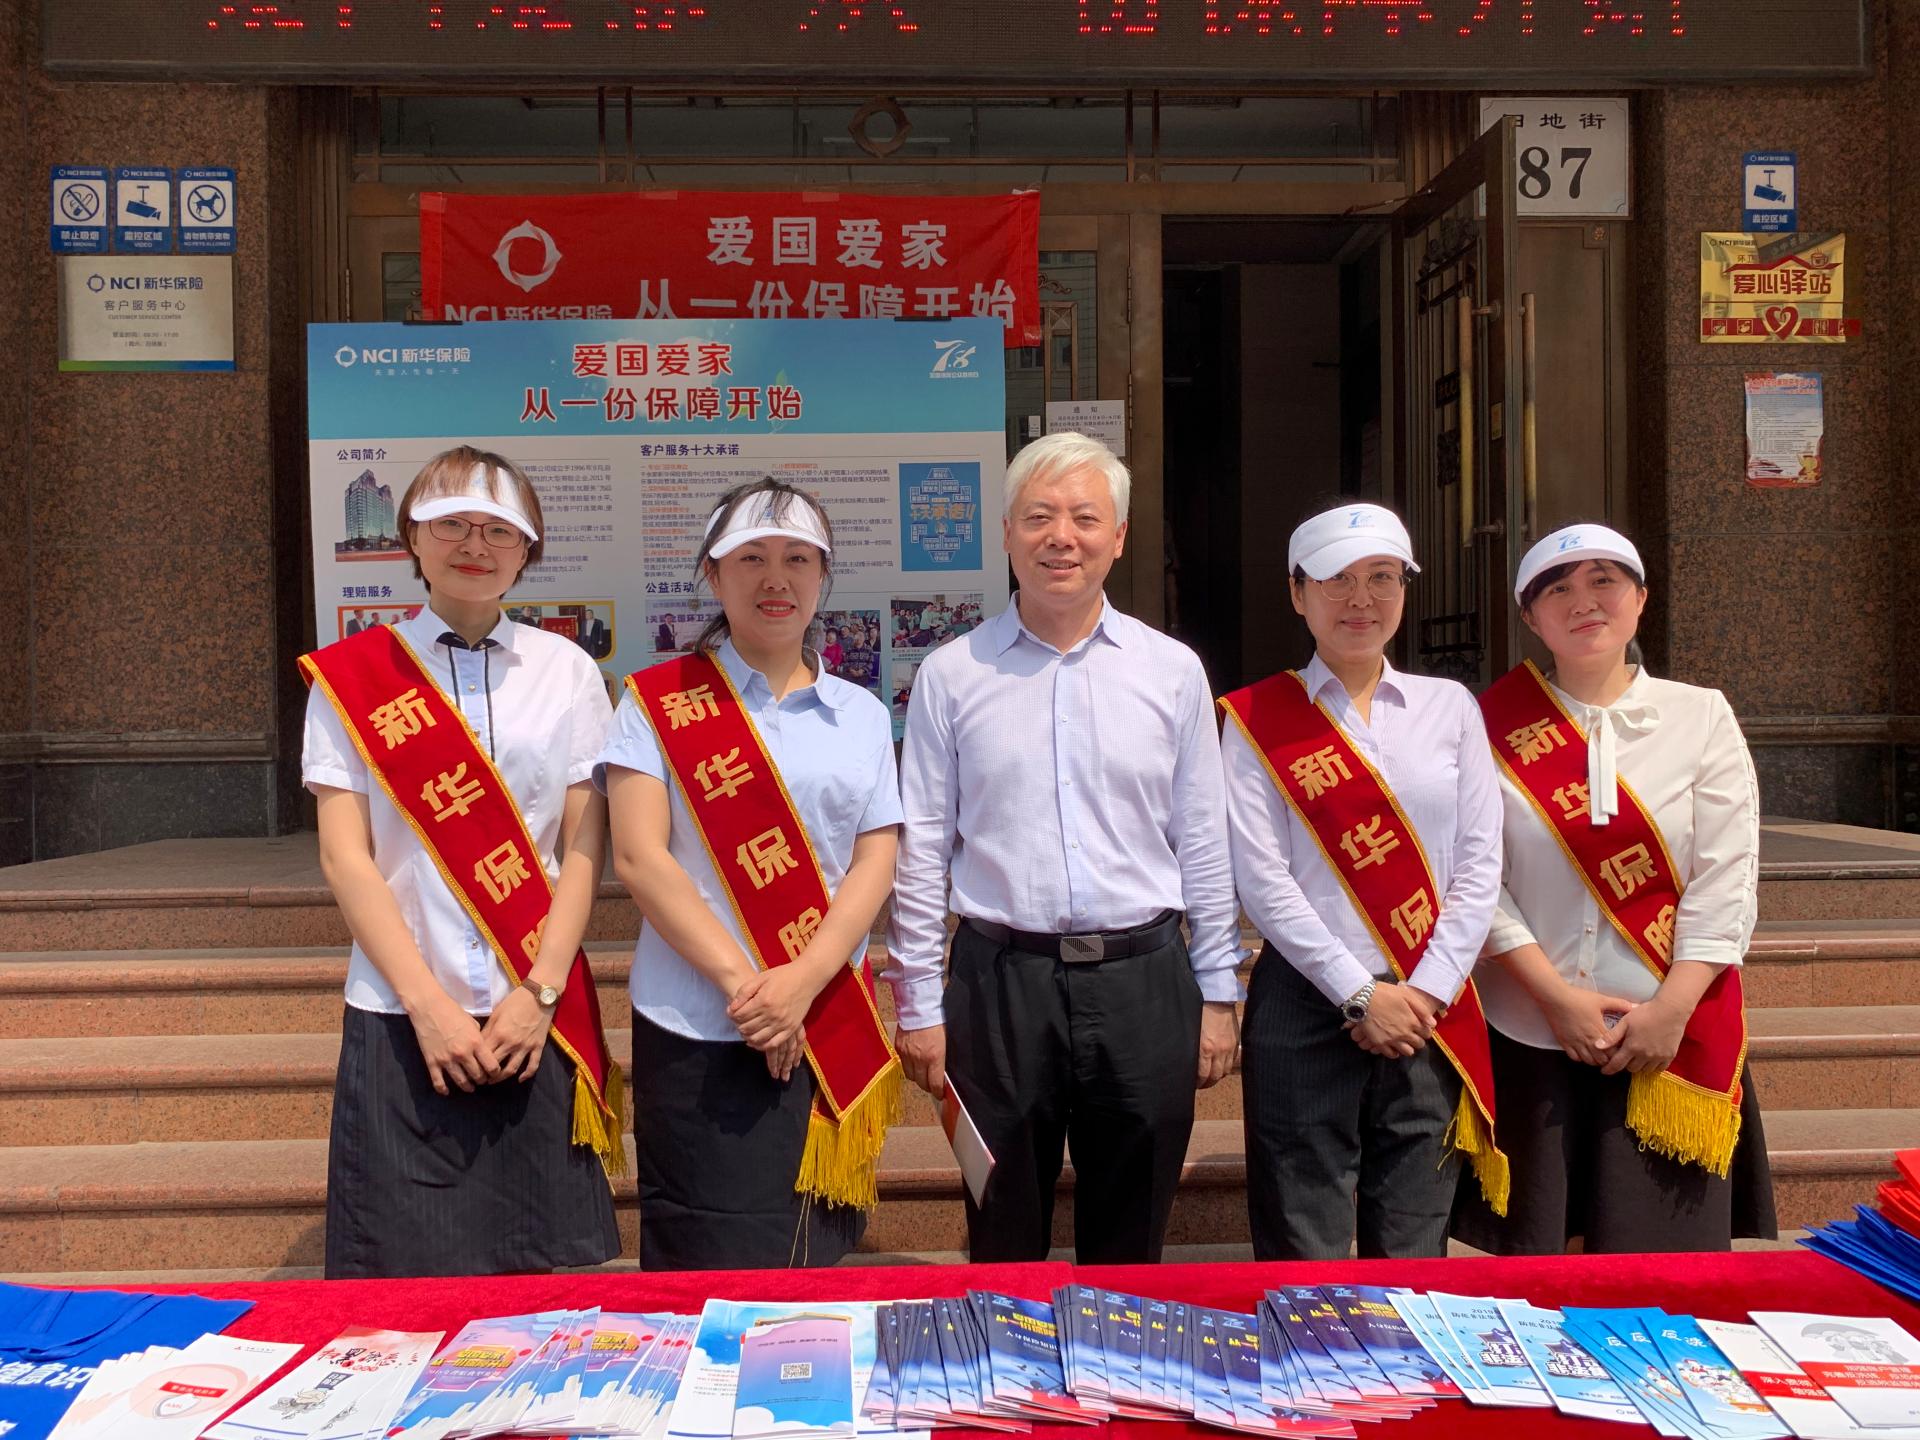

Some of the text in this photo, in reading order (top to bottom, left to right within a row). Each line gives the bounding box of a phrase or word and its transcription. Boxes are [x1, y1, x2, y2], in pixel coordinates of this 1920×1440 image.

[1518, 146, 1592, 199] 87
[1752, 214, 1788, 224] 监控区域
[61, 231, 99, 241] 禁止吸烟
[124, 231, 163, 241] 监控区域
[184, 232, 231, 241] 请勿携带宠物
[706, 215, 948, 270] 爱国爱家
[110, 276, 203, 290] NCI 新华保险
[1733, 269, 1832, 295] 爱心驿站
[104, 300, 186, 311] 客户服务中心
[634, 278, 1017, 329] 从一份保障开始
[362, 347, 471, 364] NCI 新华保险
[573, 343, 733, 377] 爱国爱家
[520, 385, 802, 423] 从一份保障开始
[337, 448, 388, 461] 公司简介
[640, 443, 740, 457] 客户服务十大承诺
[342, 586, 393, 598] 理赔服务
[645, 582, 695, 594] 公益活动
[659, 683, 824, 963] 新华保险
[1289, 744, 1434, 950] 新华保
